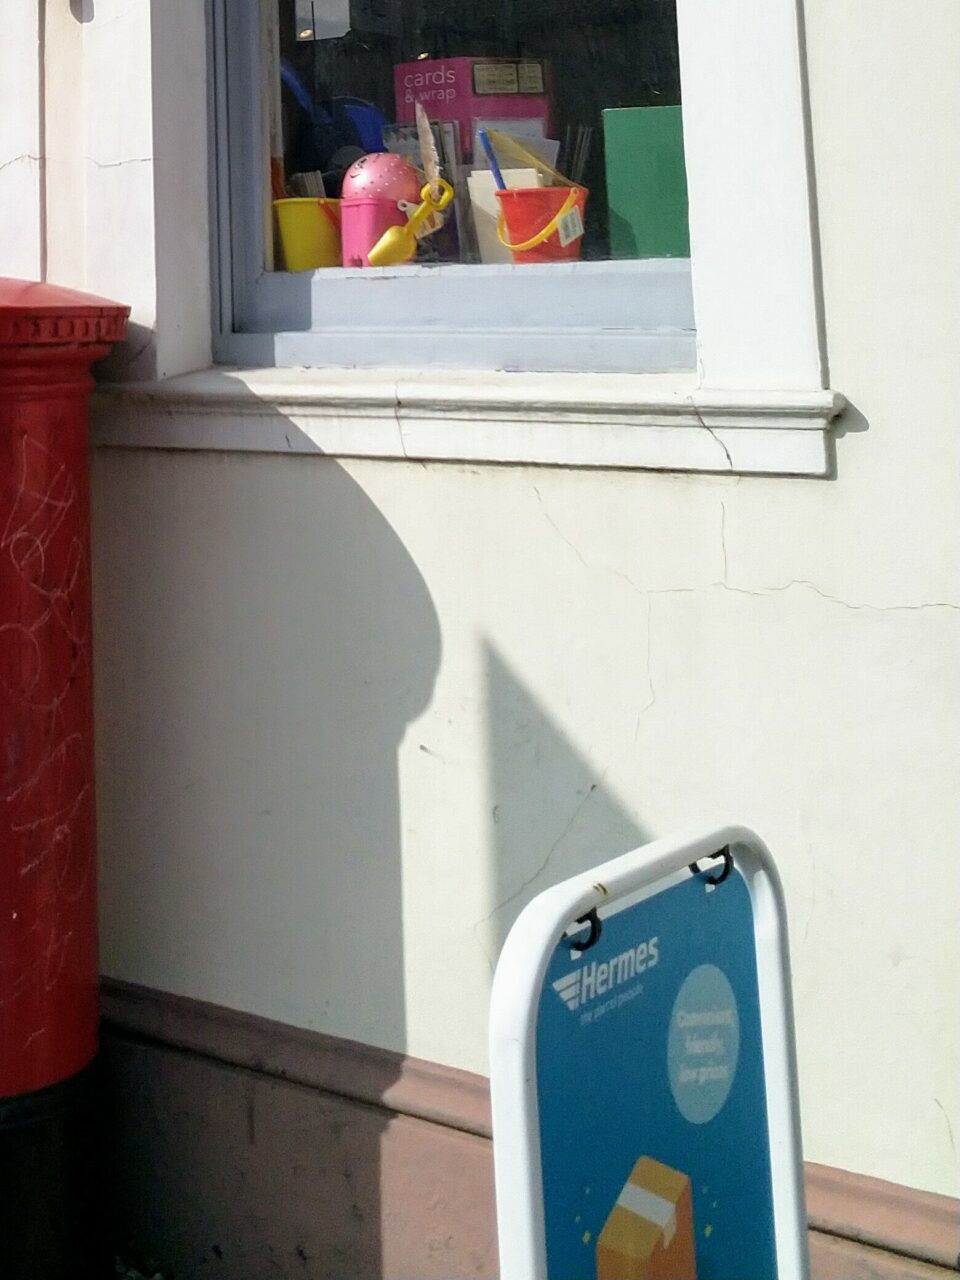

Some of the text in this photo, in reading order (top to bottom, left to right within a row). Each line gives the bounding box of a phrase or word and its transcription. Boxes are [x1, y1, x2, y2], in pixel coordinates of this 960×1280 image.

[404, 65, 456, 88] cards
[404, 88, 457, 104] & wrap
[581, 936, 660, 1004] Hermes
